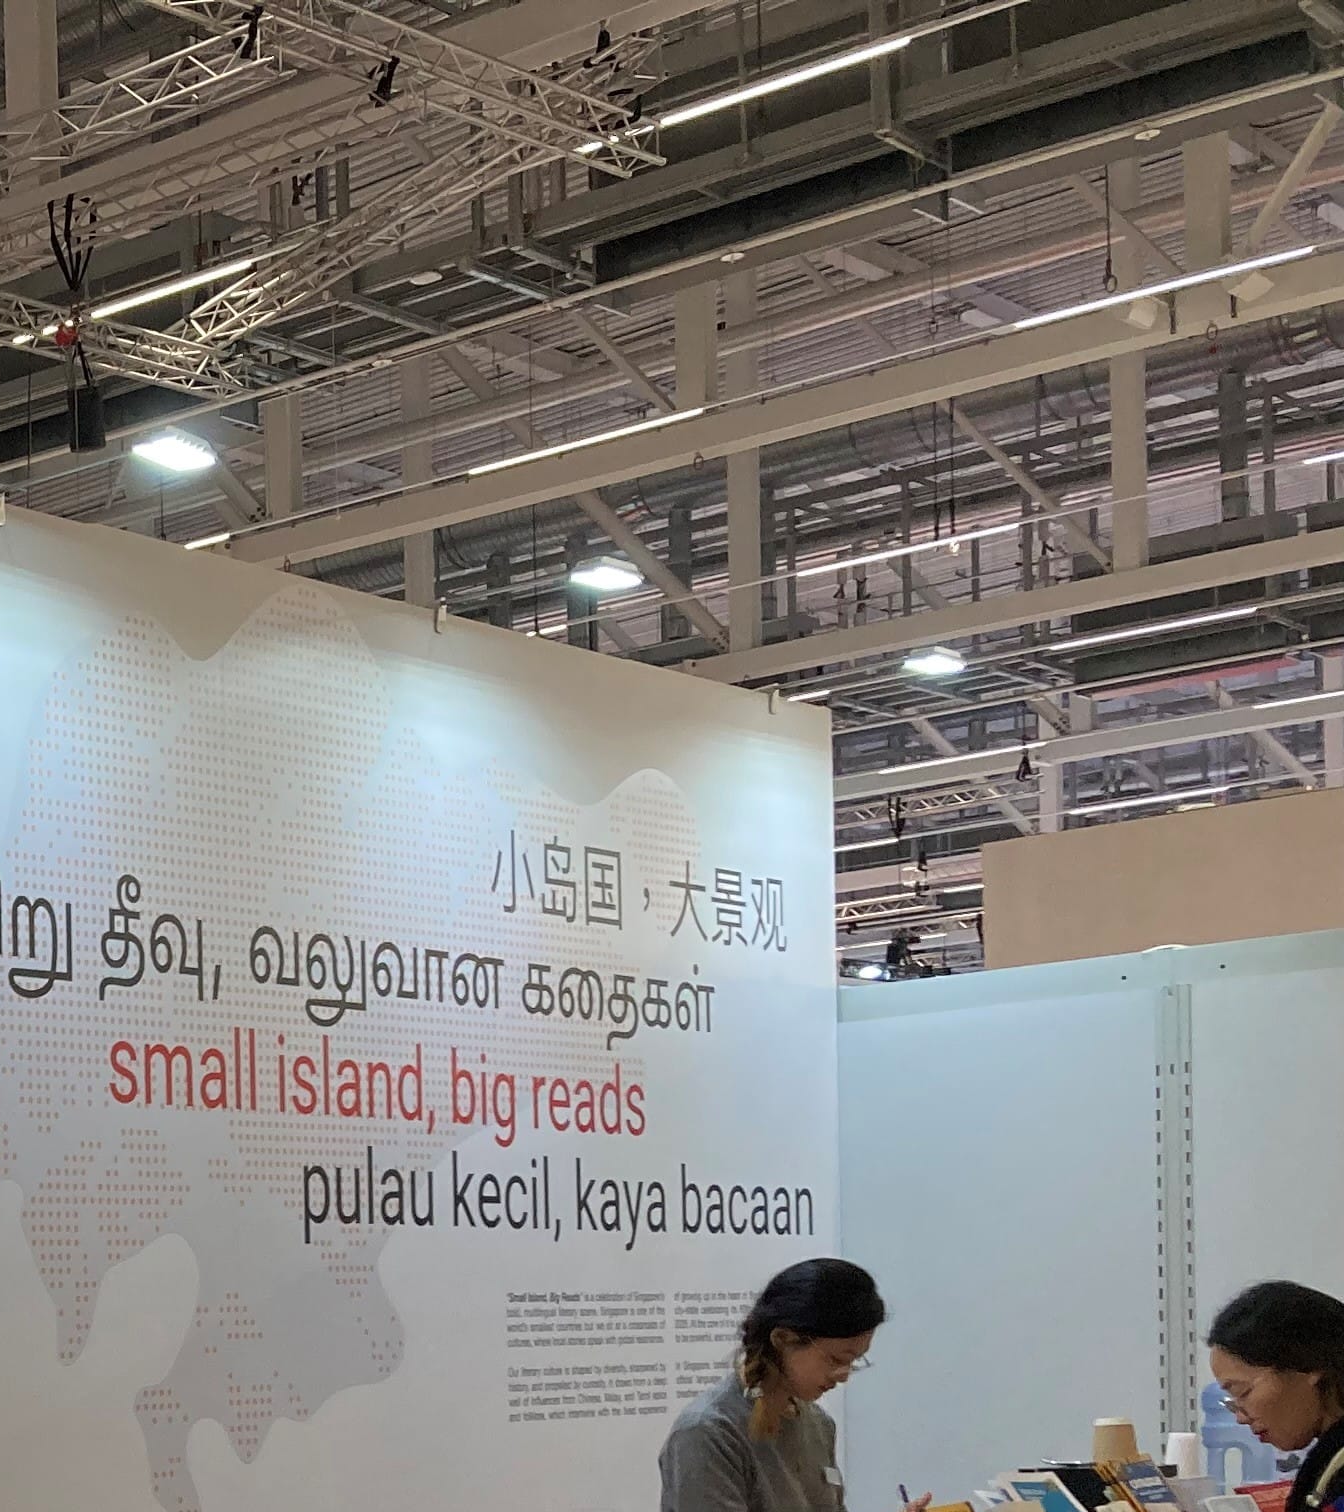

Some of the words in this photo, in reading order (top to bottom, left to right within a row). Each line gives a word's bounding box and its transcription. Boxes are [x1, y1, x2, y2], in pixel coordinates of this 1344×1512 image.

[491, 828, 788, 954] 小岛国，大景观
[99, 873, 222, 1002] தீவு,
[249, 924, 505, 1026] வலுவான
[521, 963, 716, 1050] கதைகள்
[110, 1026, 258, 1111] small
[277, 1034, 436, 1134] island,
[451, 1044, 517, 1147] big
[532, 1065, 647, 1137] reads
[303, 1146, 434, 1243] pulau
[453, 1152, 562, 1241] kecil,
[576, 1158, 669, 1254] kaya
[683, 1163, 815, 1237] bacaan
